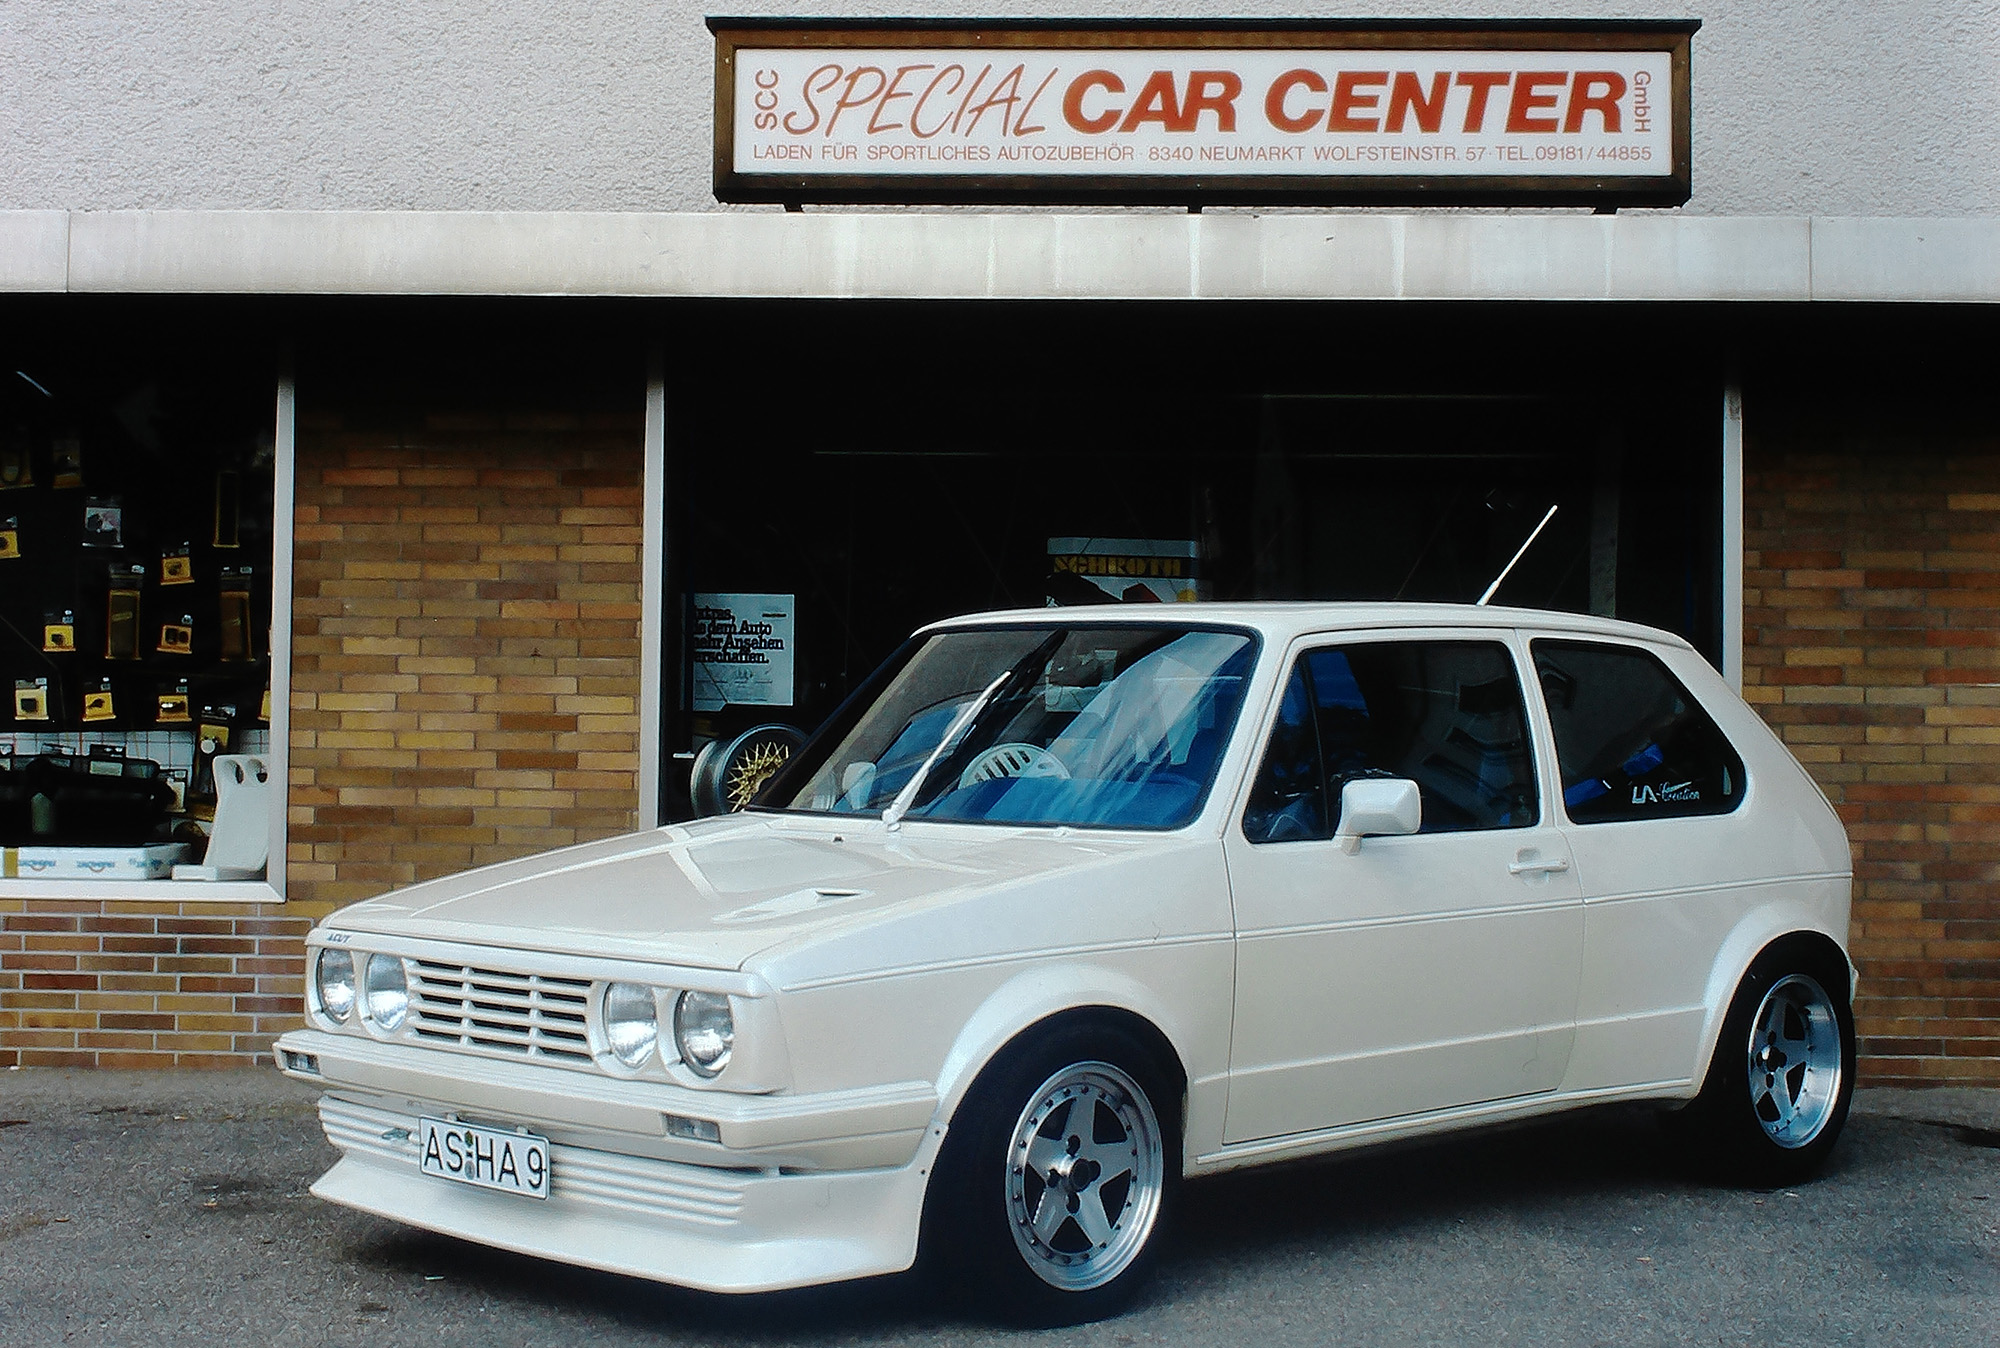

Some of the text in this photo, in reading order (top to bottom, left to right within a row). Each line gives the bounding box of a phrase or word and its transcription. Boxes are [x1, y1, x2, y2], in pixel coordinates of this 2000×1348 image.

[755, 69, 779, 131] SCC
[783, 63, 1627, 139] SPECIAL CAR CENTER
[1633, 71, 1651, 133] GmbH
[754, 145, 812, 160] LADEN
[822, 142, 858, 160] FÜR
[867, 145, 991, 161] SPORTLICHES
[998, 142, 1135, 161] AUTOZUBEHÖR
[1149, 145, 1194, 161] 8340
[1200, 145, 1304, 161] NEUMARKT
[1314, 145, 1460, 161] WOLFSTEINSTR.
[723, 635, 785, 650] Ansehen
[739, 620, 772, 635] Auto
